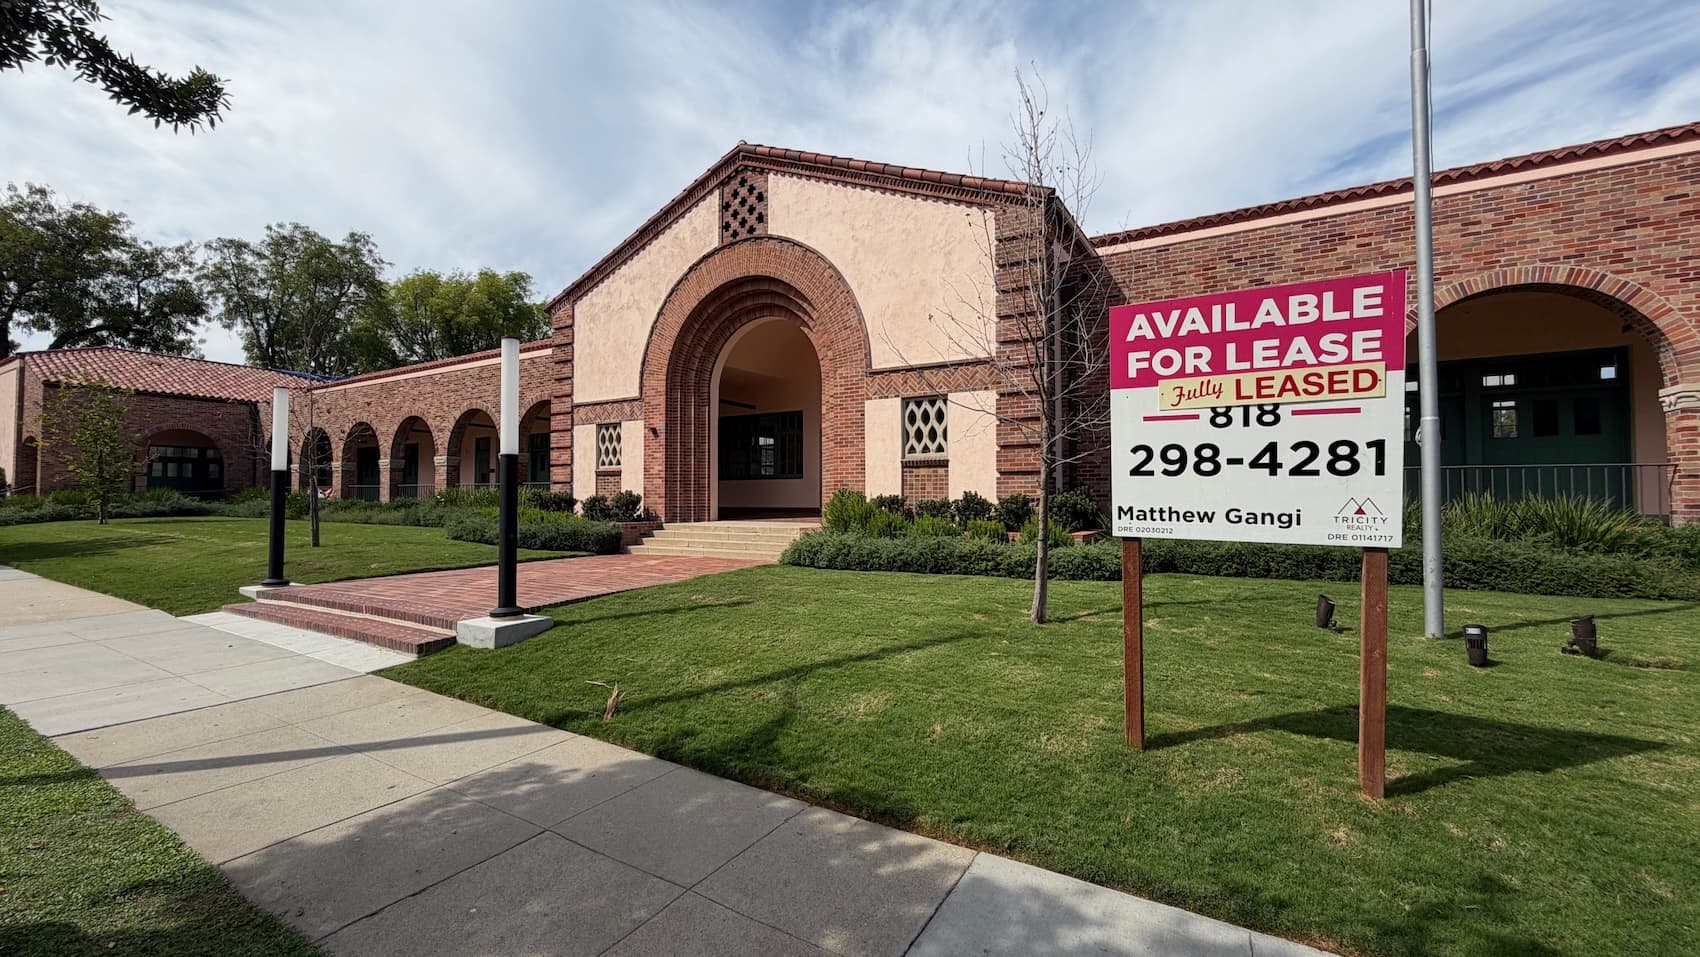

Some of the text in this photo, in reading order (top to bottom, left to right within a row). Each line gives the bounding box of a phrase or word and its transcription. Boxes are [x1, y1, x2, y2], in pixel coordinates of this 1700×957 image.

[1126, 285, 1384, 342] AVAILABLE
[1127, 329, 1383, 378] FOR LEASE
[1170, 368, 1378, 407] Fully LEASED
[1209, 403, 1281, 429] 818
[1129, 439, 1386, 477] 298-4281
[1117, 505, 1301, 529] Matthew Gangi
[1135, 526, 1173, 534] 02030212
[1333, 515, 1388, 525] TRICITY
[1327, 533, 1394, 543] DRE 01141717
